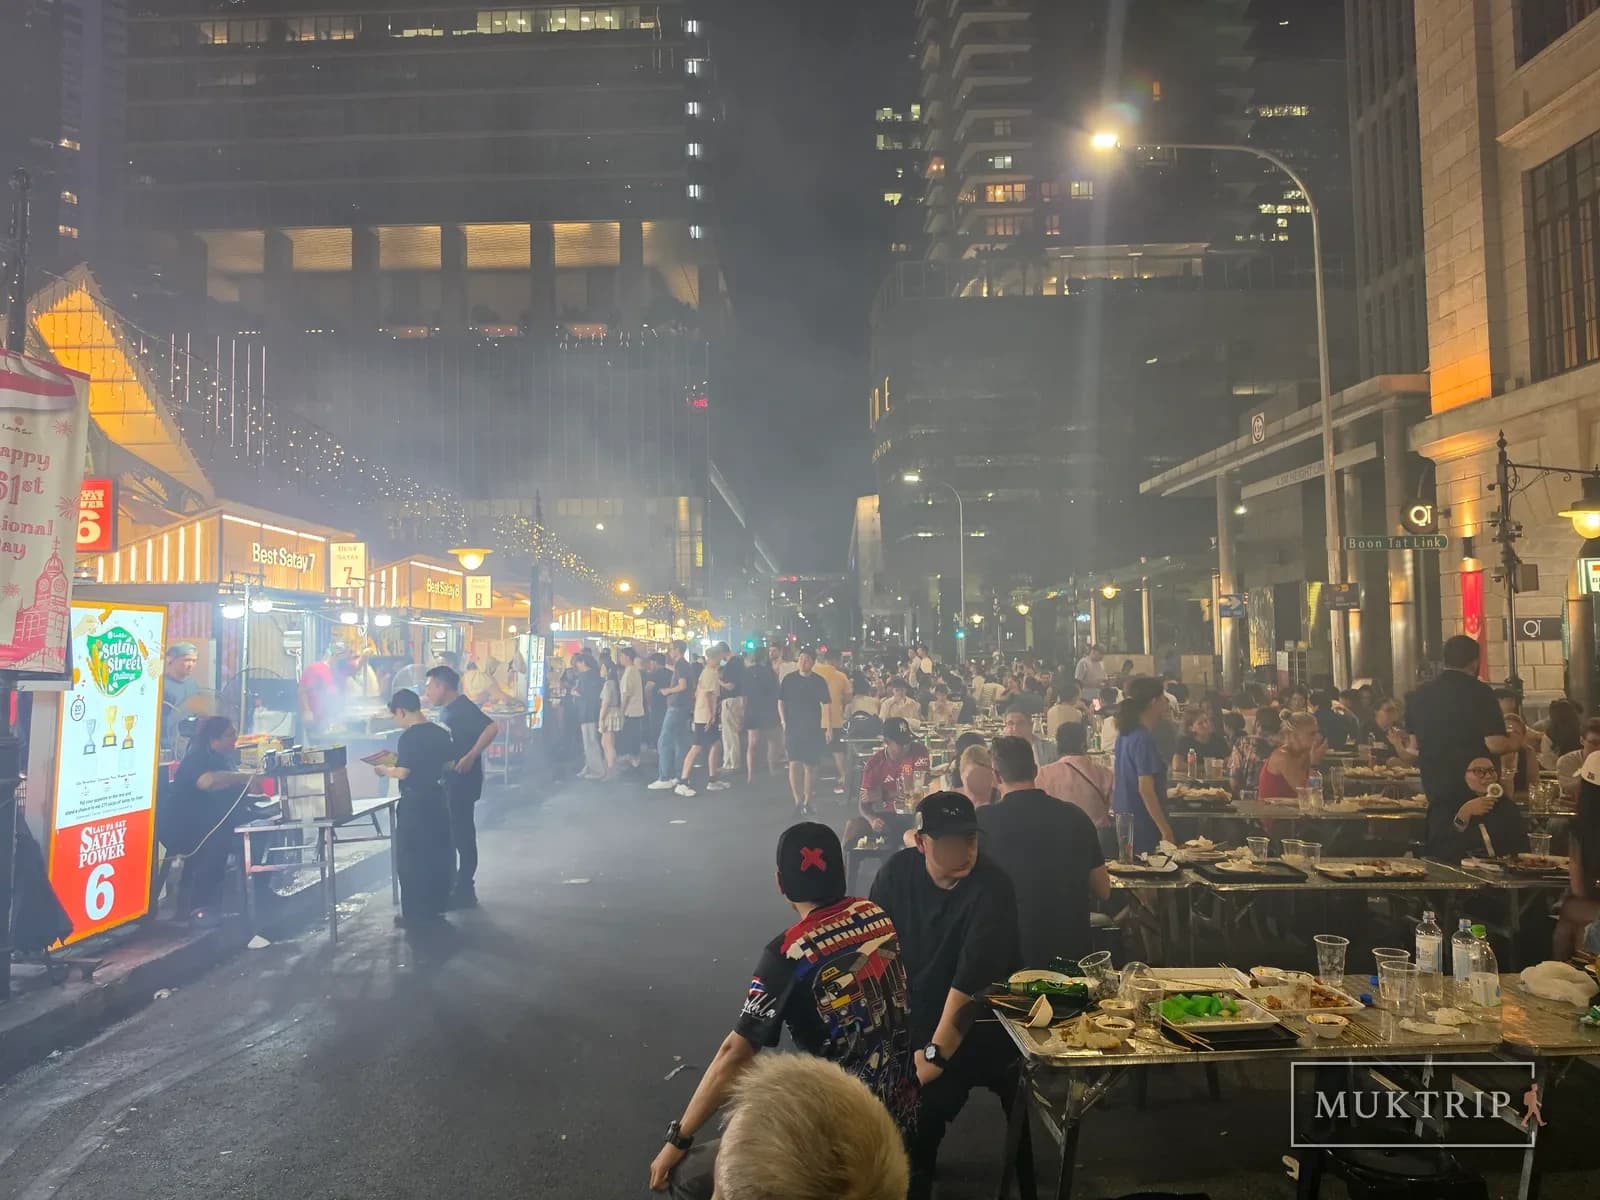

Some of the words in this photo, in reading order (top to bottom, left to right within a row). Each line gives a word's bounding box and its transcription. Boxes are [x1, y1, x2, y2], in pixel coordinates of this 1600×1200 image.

[77, 510, 101, 543] 6
[0, 540, 26, 560] ay
[1349, 538, 1382, 549] Boon
[1414, 536, 1441, 548] Link
[252, 542, 278, 565] Best
[279, 547, 308, 573] Satay
[309, 553, 316, 571] 7
[343, 566, 353, 585] 7
[80, 826, 127, 853] SATAY
[78, 844, 125, 868] POWER
[85, 863, 115, 920] 6
